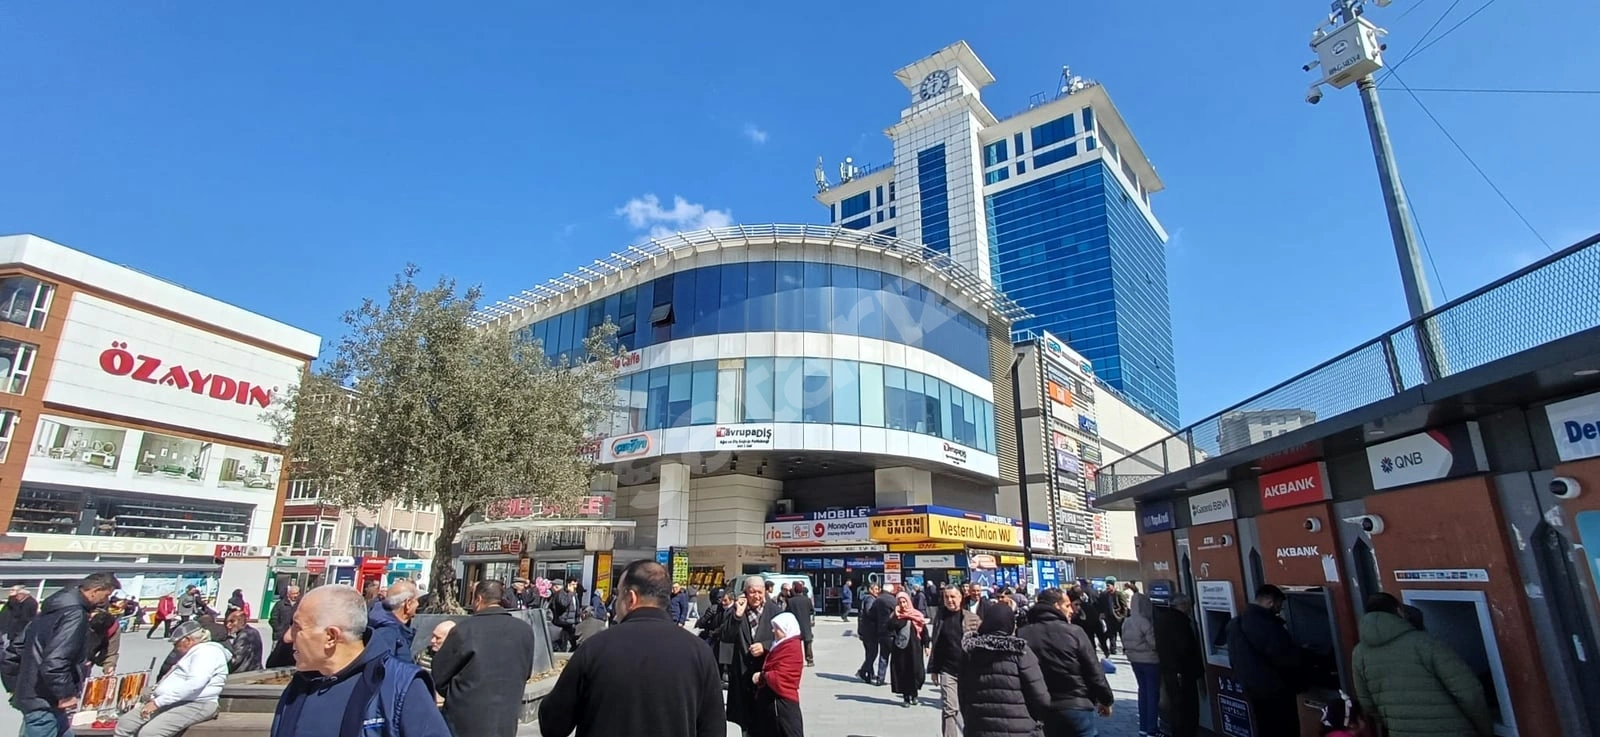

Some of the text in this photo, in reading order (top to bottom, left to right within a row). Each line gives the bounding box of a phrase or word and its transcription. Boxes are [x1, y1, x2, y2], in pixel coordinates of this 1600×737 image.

[99, 340, 271, 408] ÖZAYDIN
[1394, 451, 1423, 469] QNB
[1264, 476, 1316, 498] AKBANK
[1212, 499, 1229, 511] BBVA
[814, 508, 867, 520] IMOBILE
[827, 521, 868, 530] MoneyGram
[872, 517, 920, 527] WESTERN
[766, 526, 781, 539] ria
[887, 526, 920, 535] UNION
[939, 519, 1011, 542] Western Union WU
[476, 540, 502, 551] BURGER
[1276, 546, 1319, 558] AKBANK
